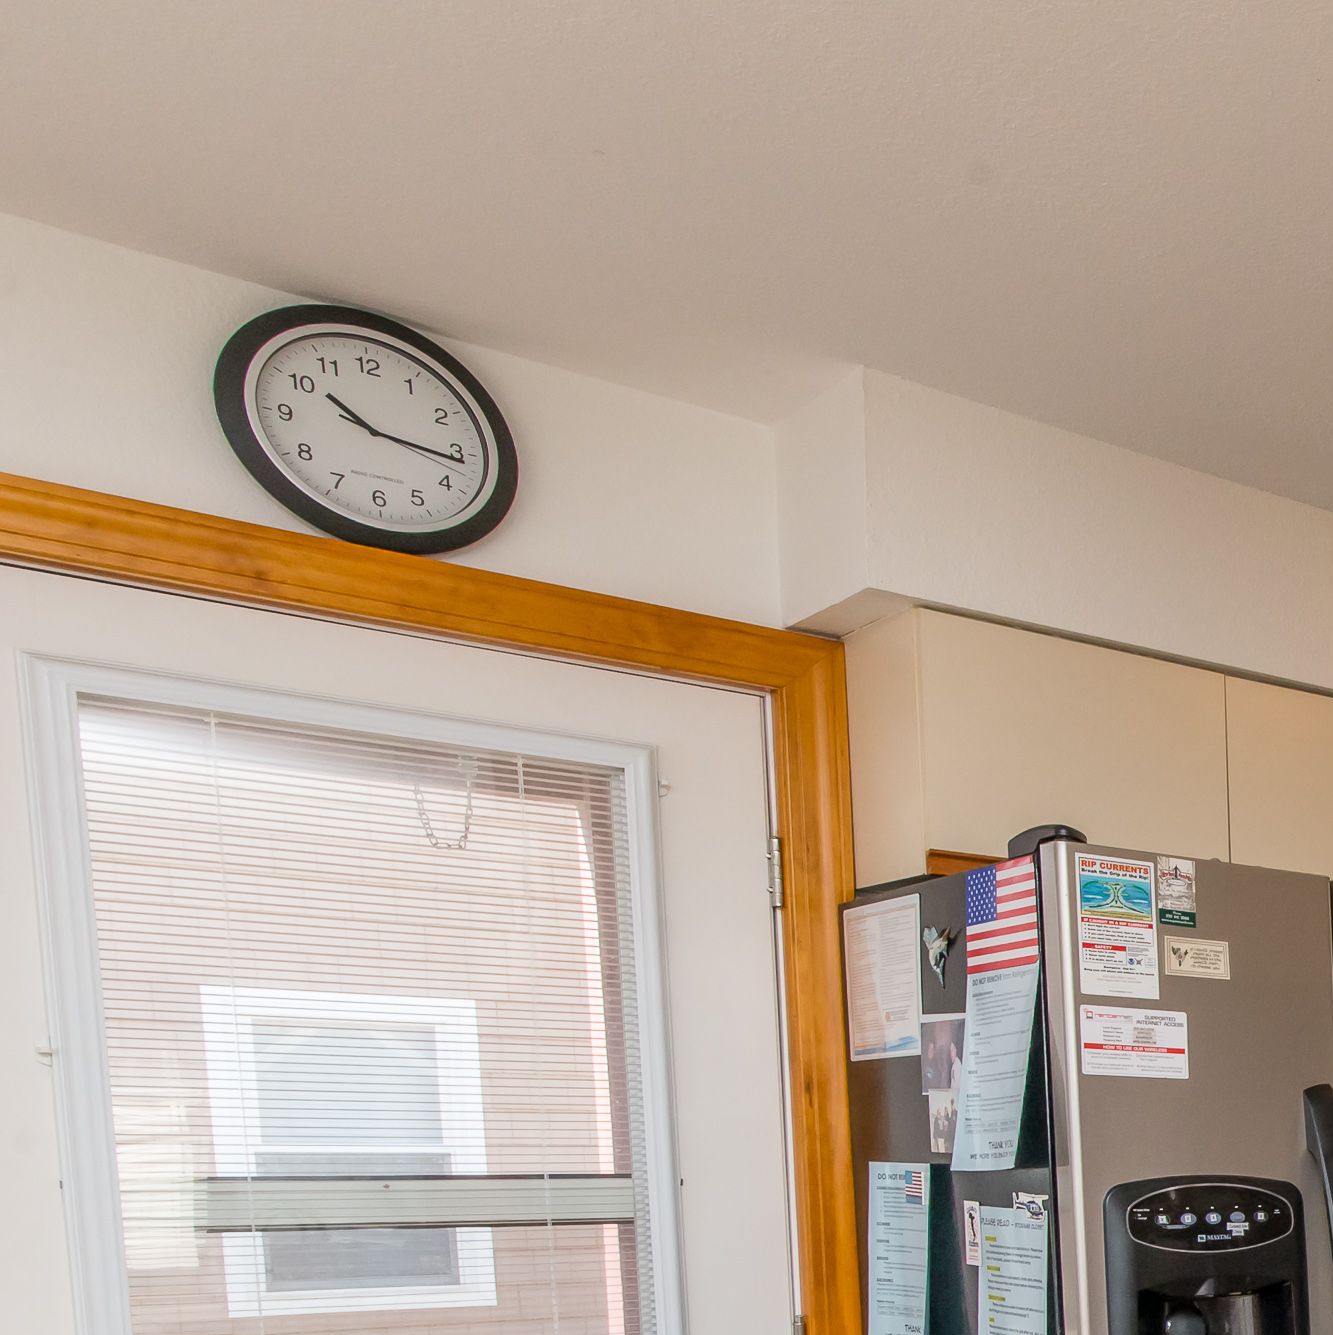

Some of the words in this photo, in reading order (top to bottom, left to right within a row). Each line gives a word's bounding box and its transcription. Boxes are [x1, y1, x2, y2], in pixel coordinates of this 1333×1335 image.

[316, 357, 338, 376] 11
[354, 356, 381, 377] 12
[288, 373, 315, 393] 10
[403, 378, 414, 395] 1
[277, 403, 293, 421] 9
[434, 408, 449, 426] 2
[297, 443, 313, 461] 8
[450, 443, 464, 461] 3
[330, 472, 345, 489] 7
[438, 475, 452, 491] 4
[372, 490, 387, 507] 6
[411, 490, 425, 506] 5
[1081, 860, 1096, 868] RIP
[1100, 862, 1148, 874] CURRENTS
